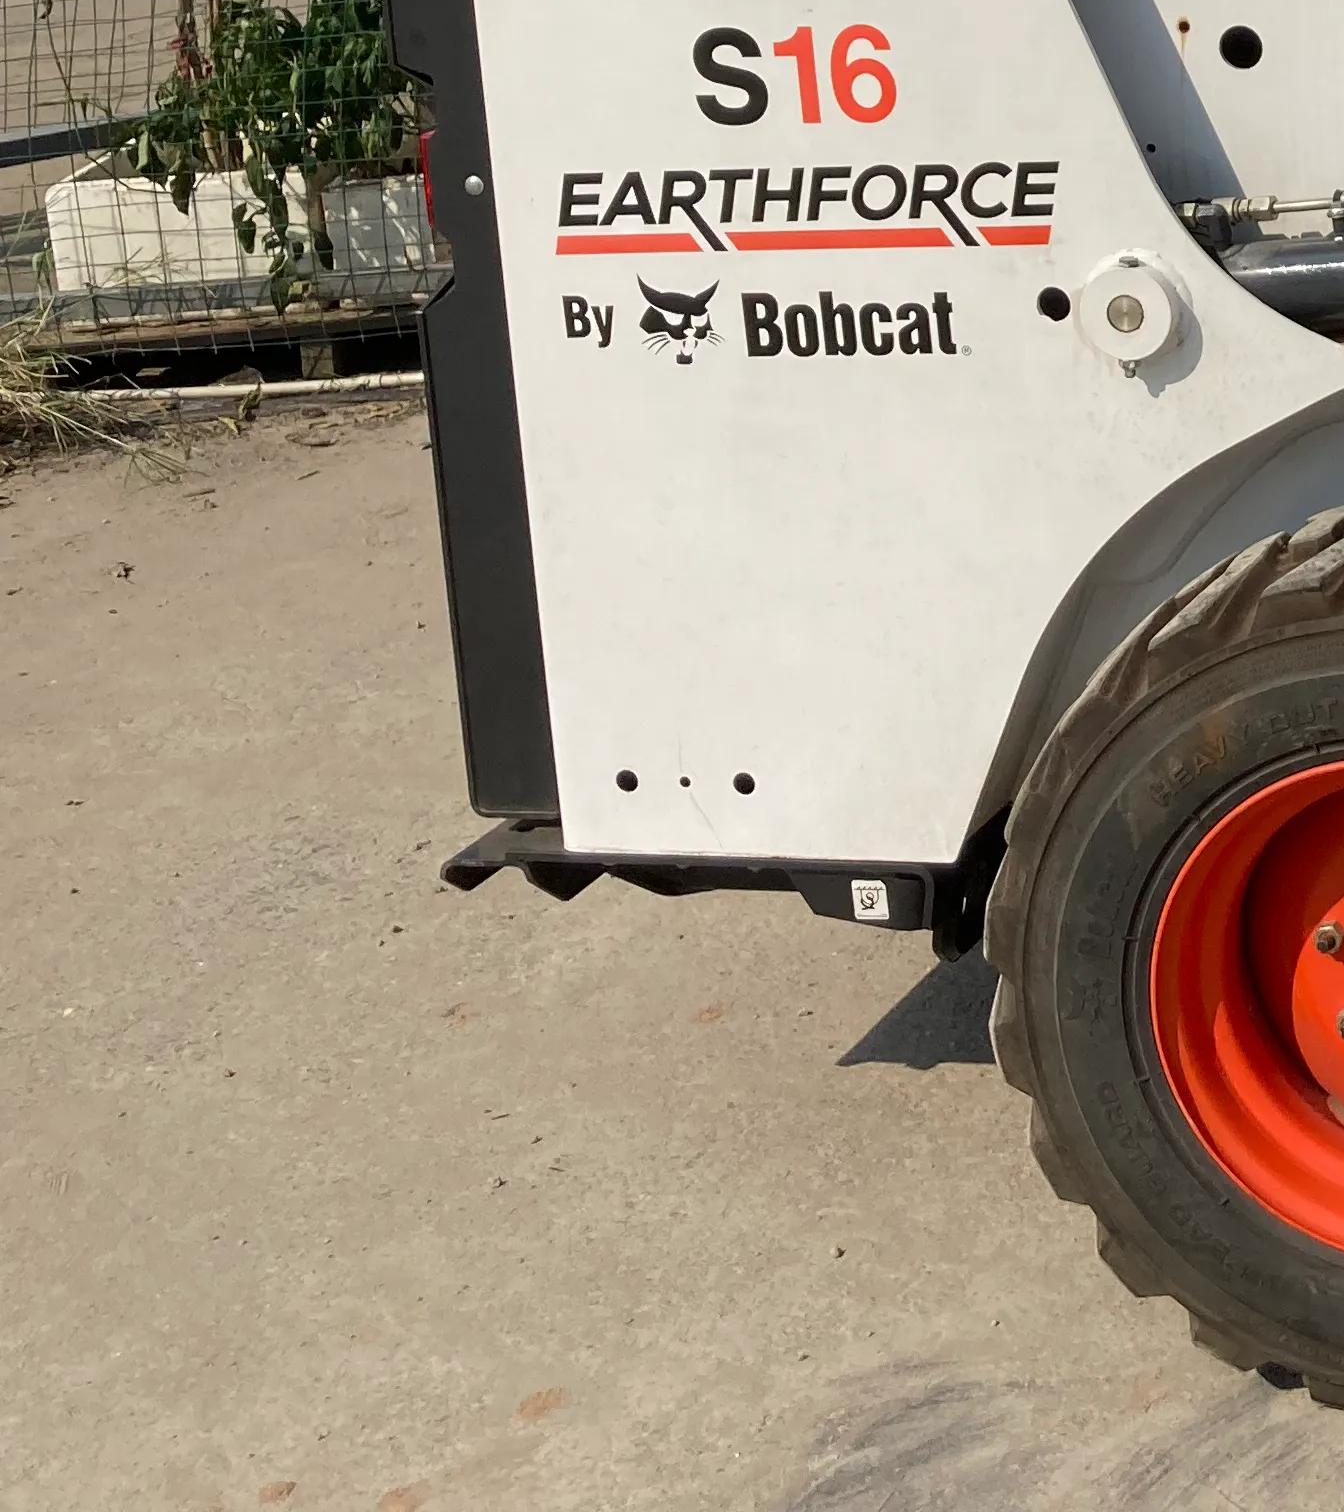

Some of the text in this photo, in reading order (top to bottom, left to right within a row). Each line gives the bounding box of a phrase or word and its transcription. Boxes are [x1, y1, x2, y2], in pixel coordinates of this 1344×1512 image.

[692, 24, 897, 126] S16
[558, 161, 1060, 252] EARTHFORCE
[562, 291, 958, 357] By Bobcat
[1145, 720, 1258, 809] HEAVY
